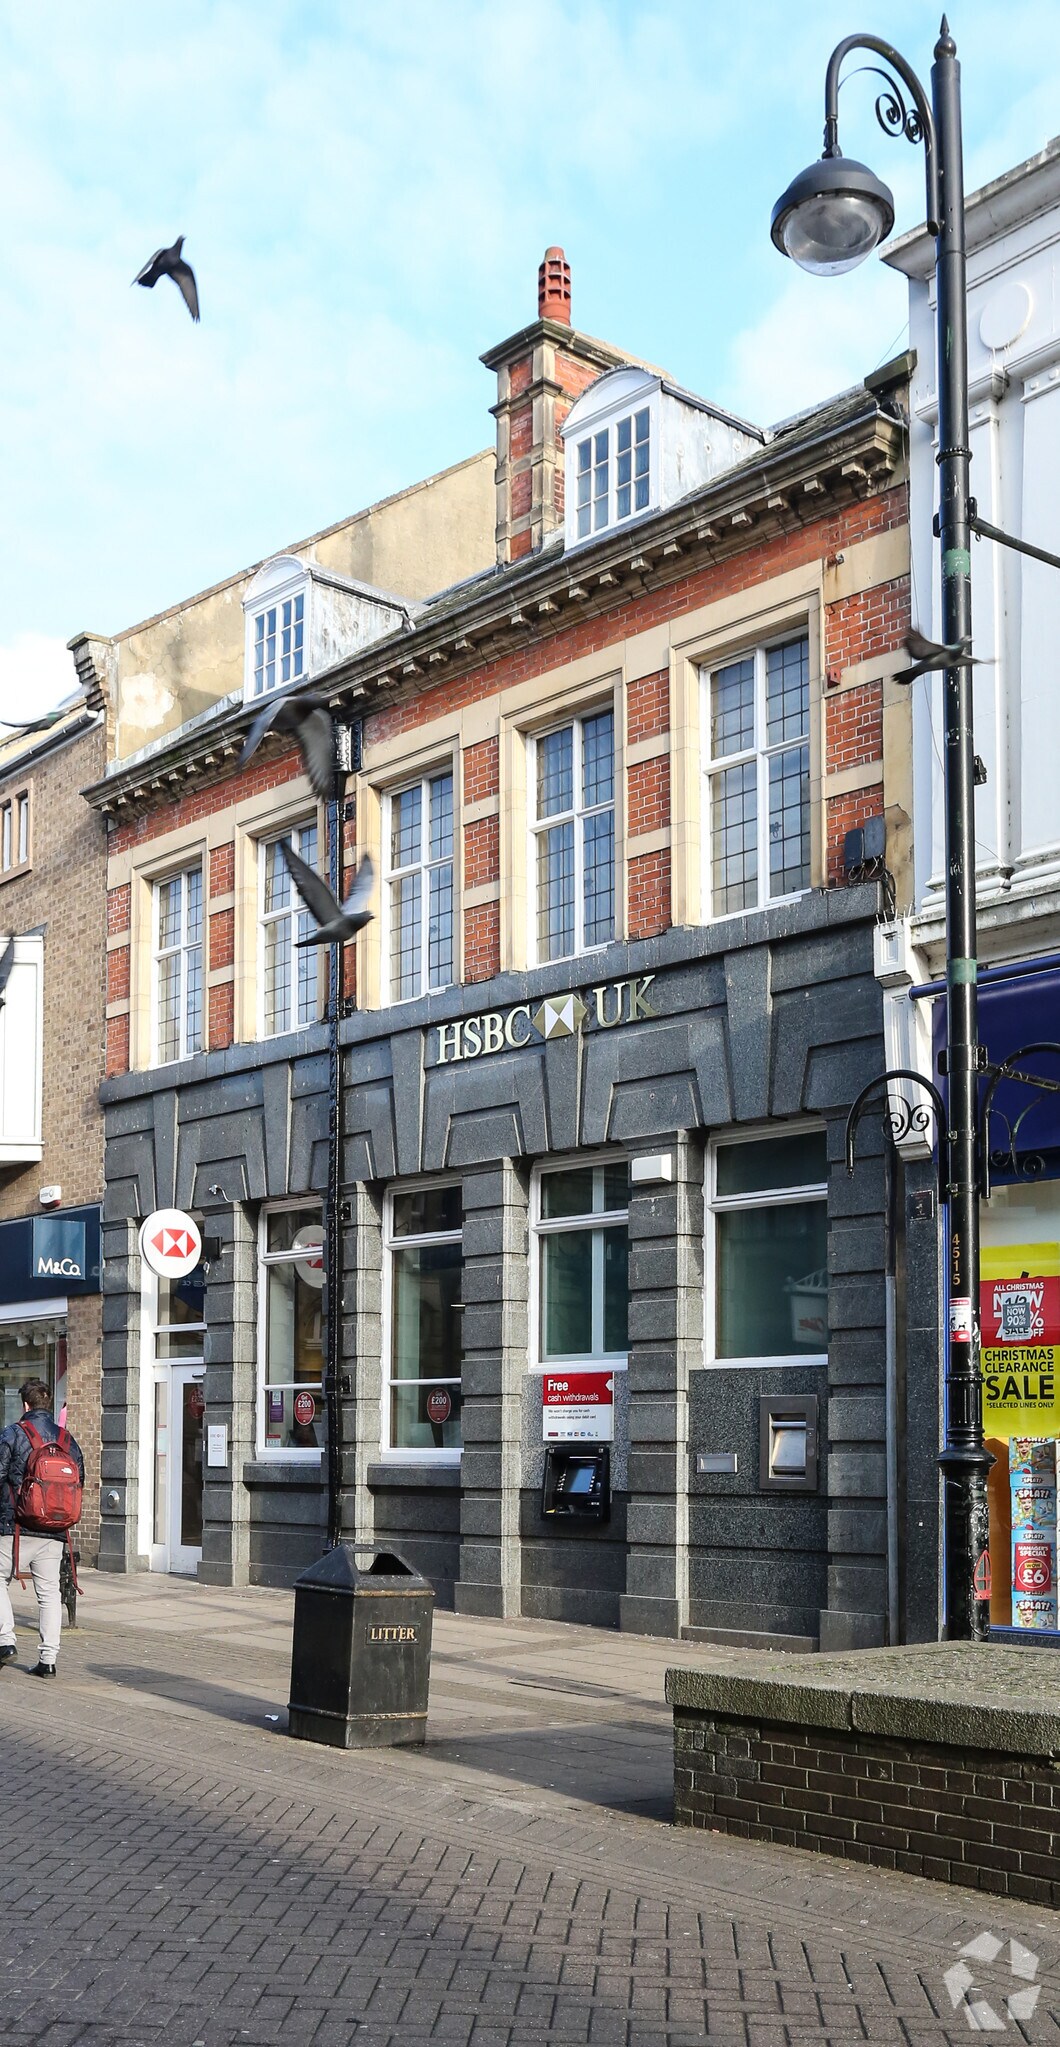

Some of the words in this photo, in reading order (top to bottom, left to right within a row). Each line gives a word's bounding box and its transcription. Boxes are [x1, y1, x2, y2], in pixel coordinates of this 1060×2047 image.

[435, 1004, 532, 1065] HSBC
[592, 974, 659, 1028] UK
[952, 1233, 961, 1286] 4515
[994, 1284, 1006, 1292] ALL
[1006, 1282, 1044, 1291] CHRISTMAS
[1007, 1308, 1026, 1316] NOW
[984, 1349, 1054, 1361] CHRISTMAS
[985, 1362, 1054, 1373] CLEARANCE
[547, 1379, 569, 1391] Free
[986, 1375, 1055, 1400] SALE
[431, 1396, 446, 1405] £200
[547, 1394, 561, 1402] cash
[562, 1393, 600, 1402] withdrawals
[297, 1400, 311, 1408] £200
[1018, 1489, 1049, 1499] SPLAT!
[1022, 1569, 1044, 1584] £6
[1019, 1601, 1050, 1611] SPLAT!
[371, 1627, 415, 1640] LITTER
